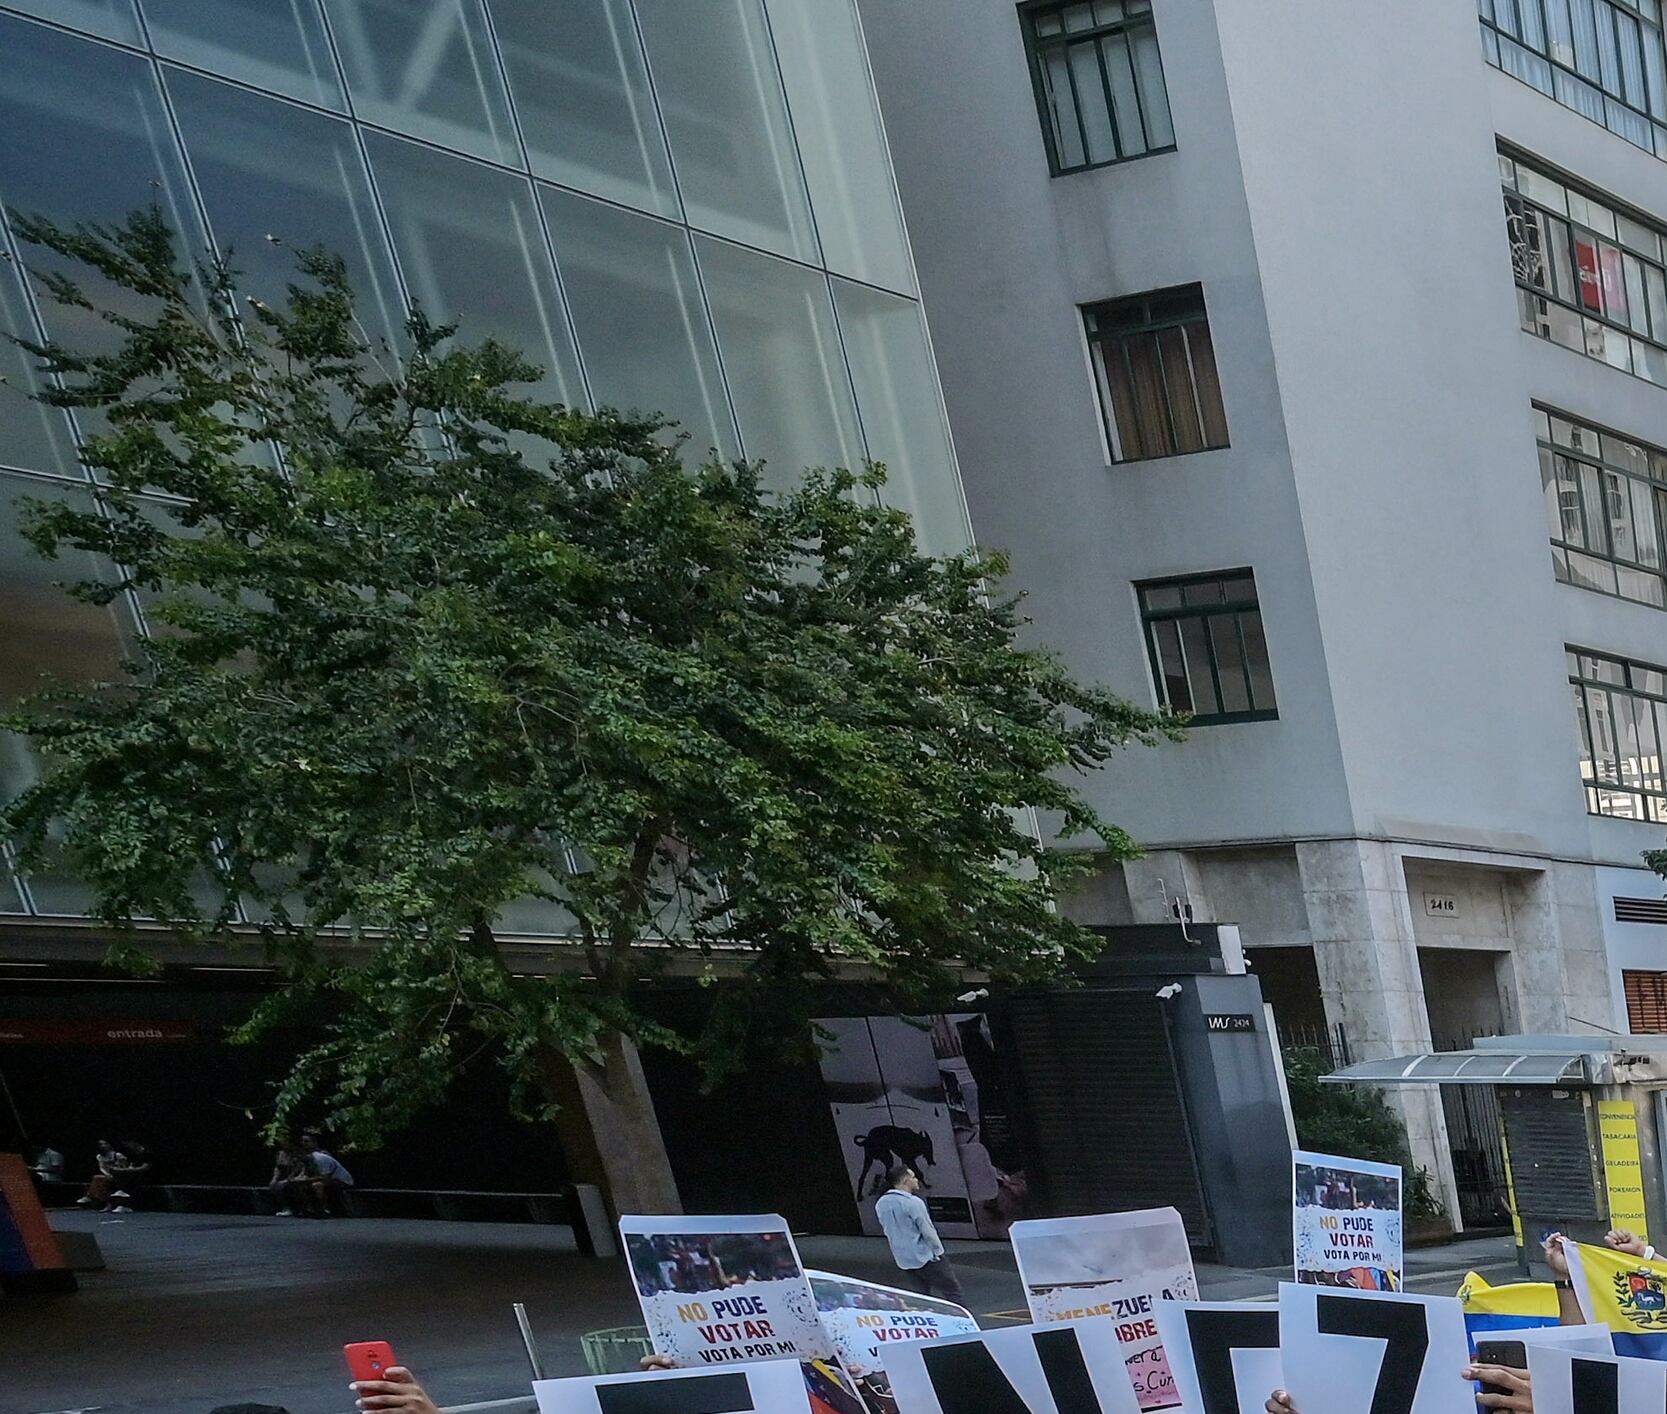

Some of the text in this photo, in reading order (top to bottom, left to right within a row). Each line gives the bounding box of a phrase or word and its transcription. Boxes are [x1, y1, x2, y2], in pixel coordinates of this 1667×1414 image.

[107, 1029, 162, 1039] entrada
[1319, 1215, 1374, 1233] NO PUDE
[1330, 1233, 1374, 1249] VOTAR
[1324, 1249, 1350, 1261] VOTA
[1352, 1250, 1371, 1261] POR
[677, 1295, 768, 1325] NO PUDE
[856, 1315, 938, 1328] NO PUDE
[698, 1319, 775, 1344] VOTAR
[872, 1328, 940, 1341] VOTAR
[1115, 1319, 1158, 1343] IBRE
[698, 1340, 797, 1364] VOTA POR MI
